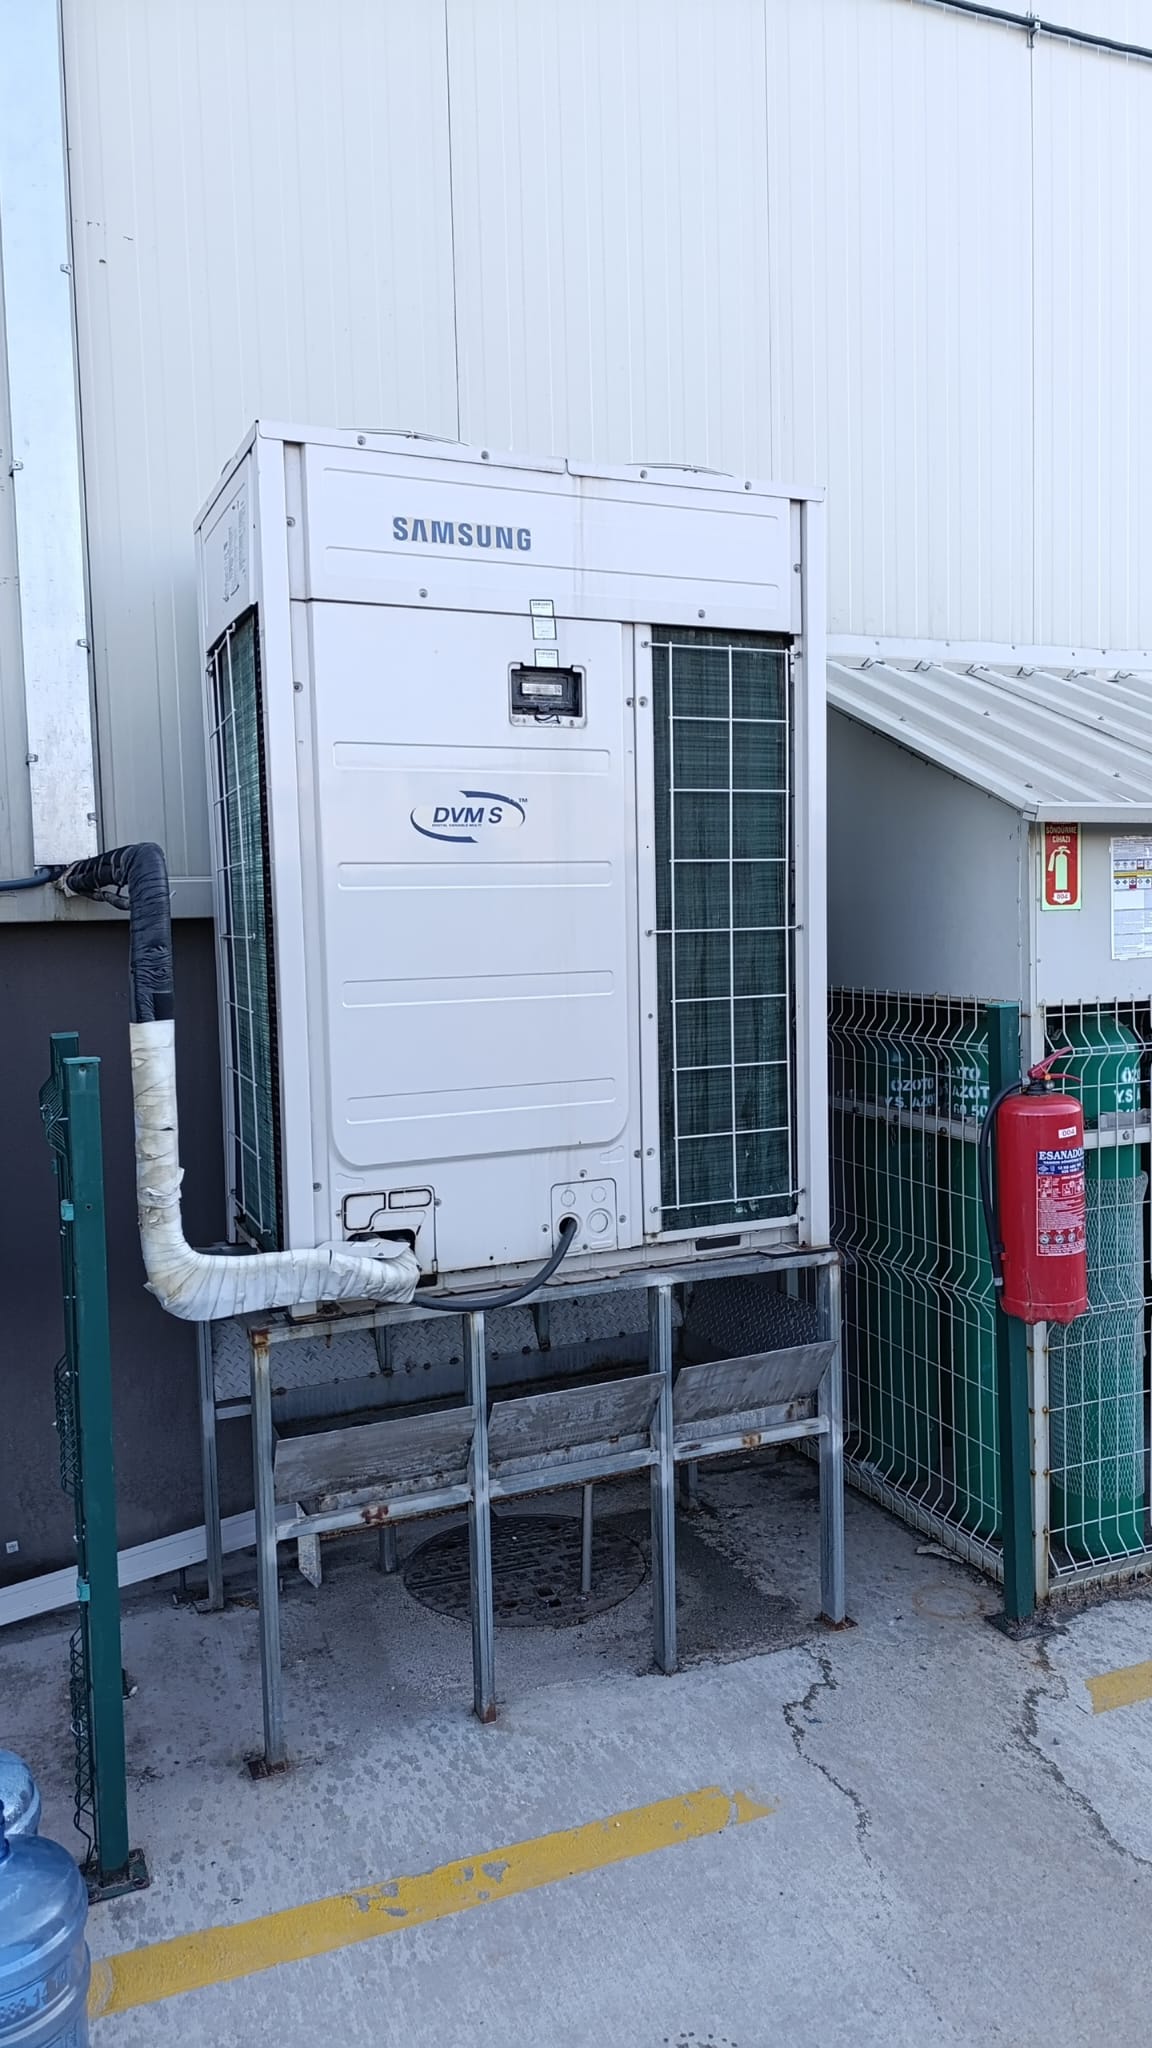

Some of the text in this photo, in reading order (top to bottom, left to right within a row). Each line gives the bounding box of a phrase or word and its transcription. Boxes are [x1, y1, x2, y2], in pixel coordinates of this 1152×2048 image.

[393, 516, 532, 551] SAMSUNG
[433, 806, 503, 824] DVM S
